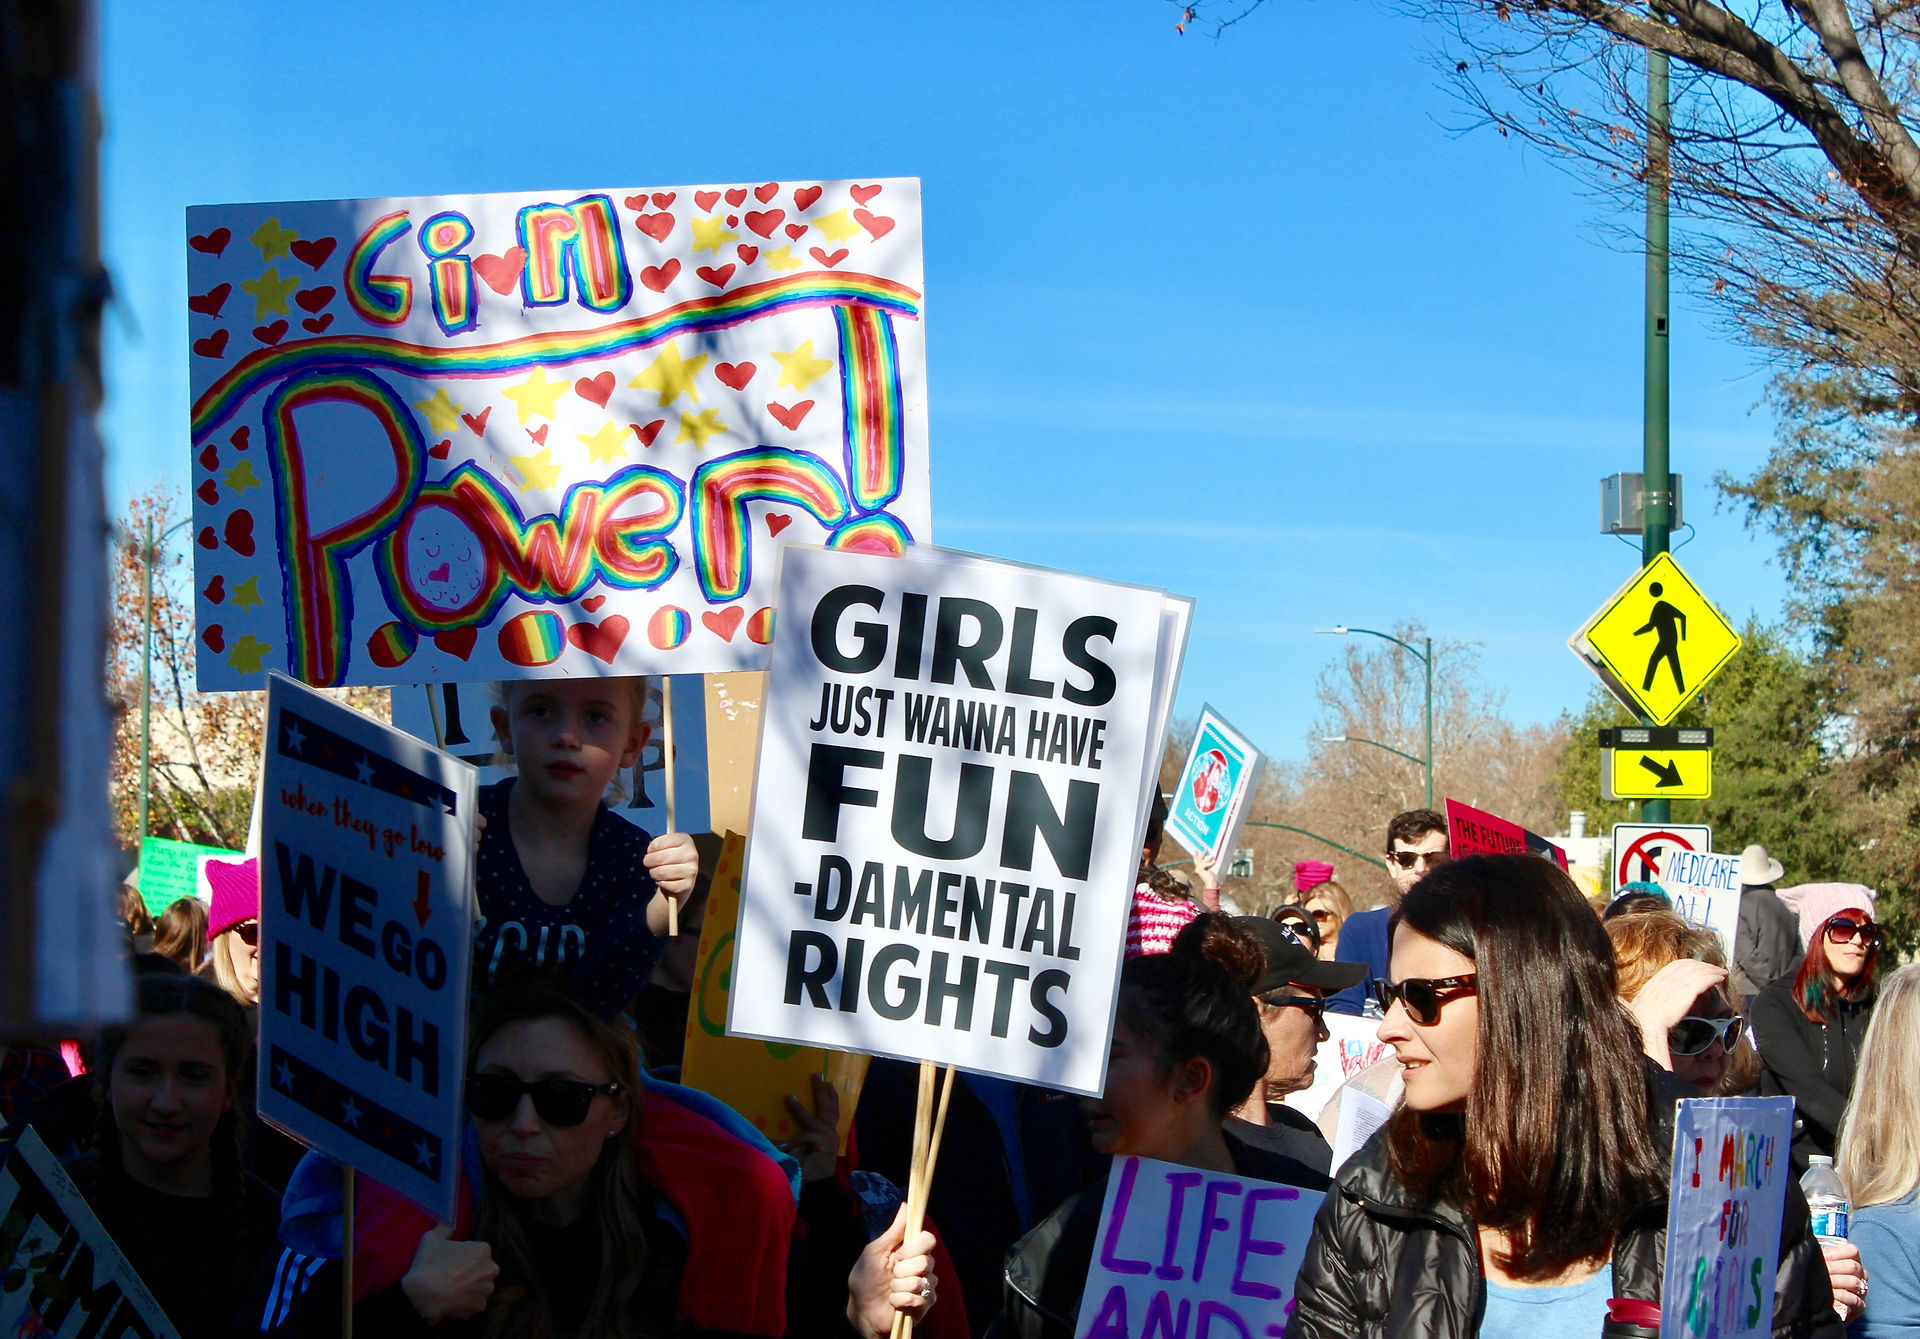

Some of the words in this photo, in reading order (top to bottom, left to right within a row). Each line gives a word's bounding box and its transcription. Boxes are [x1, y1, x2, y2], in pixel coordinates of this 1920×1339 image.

[344, 194, 634, 337] Girl
[810, 584, 1118, 707] GIRLS
[809, 682, 894, 738] JUST
[904, 692, 1016, 757] WANNA
[1025, 710, 1107, 770] HAVE
[281, 782, 327, 818] when
[332, 794, 378, 850] they
[382, 827, 407, 859] go
[411, 823, 446, 863] low
[802, 743, 1100, 881] FUN
[1184, 808, 1210, 836] ACTION
[1455, 816, 1478, 843] THE
[793, 854, 1081, 961] -DAMENTAL
[1665, 851, 1740, 890] MEDICARE
[1674, 895, 1718, 931] ALL
[1688, 886, 1707, 896] FOR
[274, 839, 378, 959] WE
[381, 920, 447, 990] GO
[275, 940, 439, 1098] HIGH
[783, 930, 1071, 1048] RIGHTS
[1692, 1137, 1703, 1188] I
[1719, 1128, 1775, 1191] MARCH
[1101, 1156, 1300, 1300] LIFE
[1719, 1199, 1750, 1249] FOR
[1687, 1256, 1763, 1339] GIRLS
